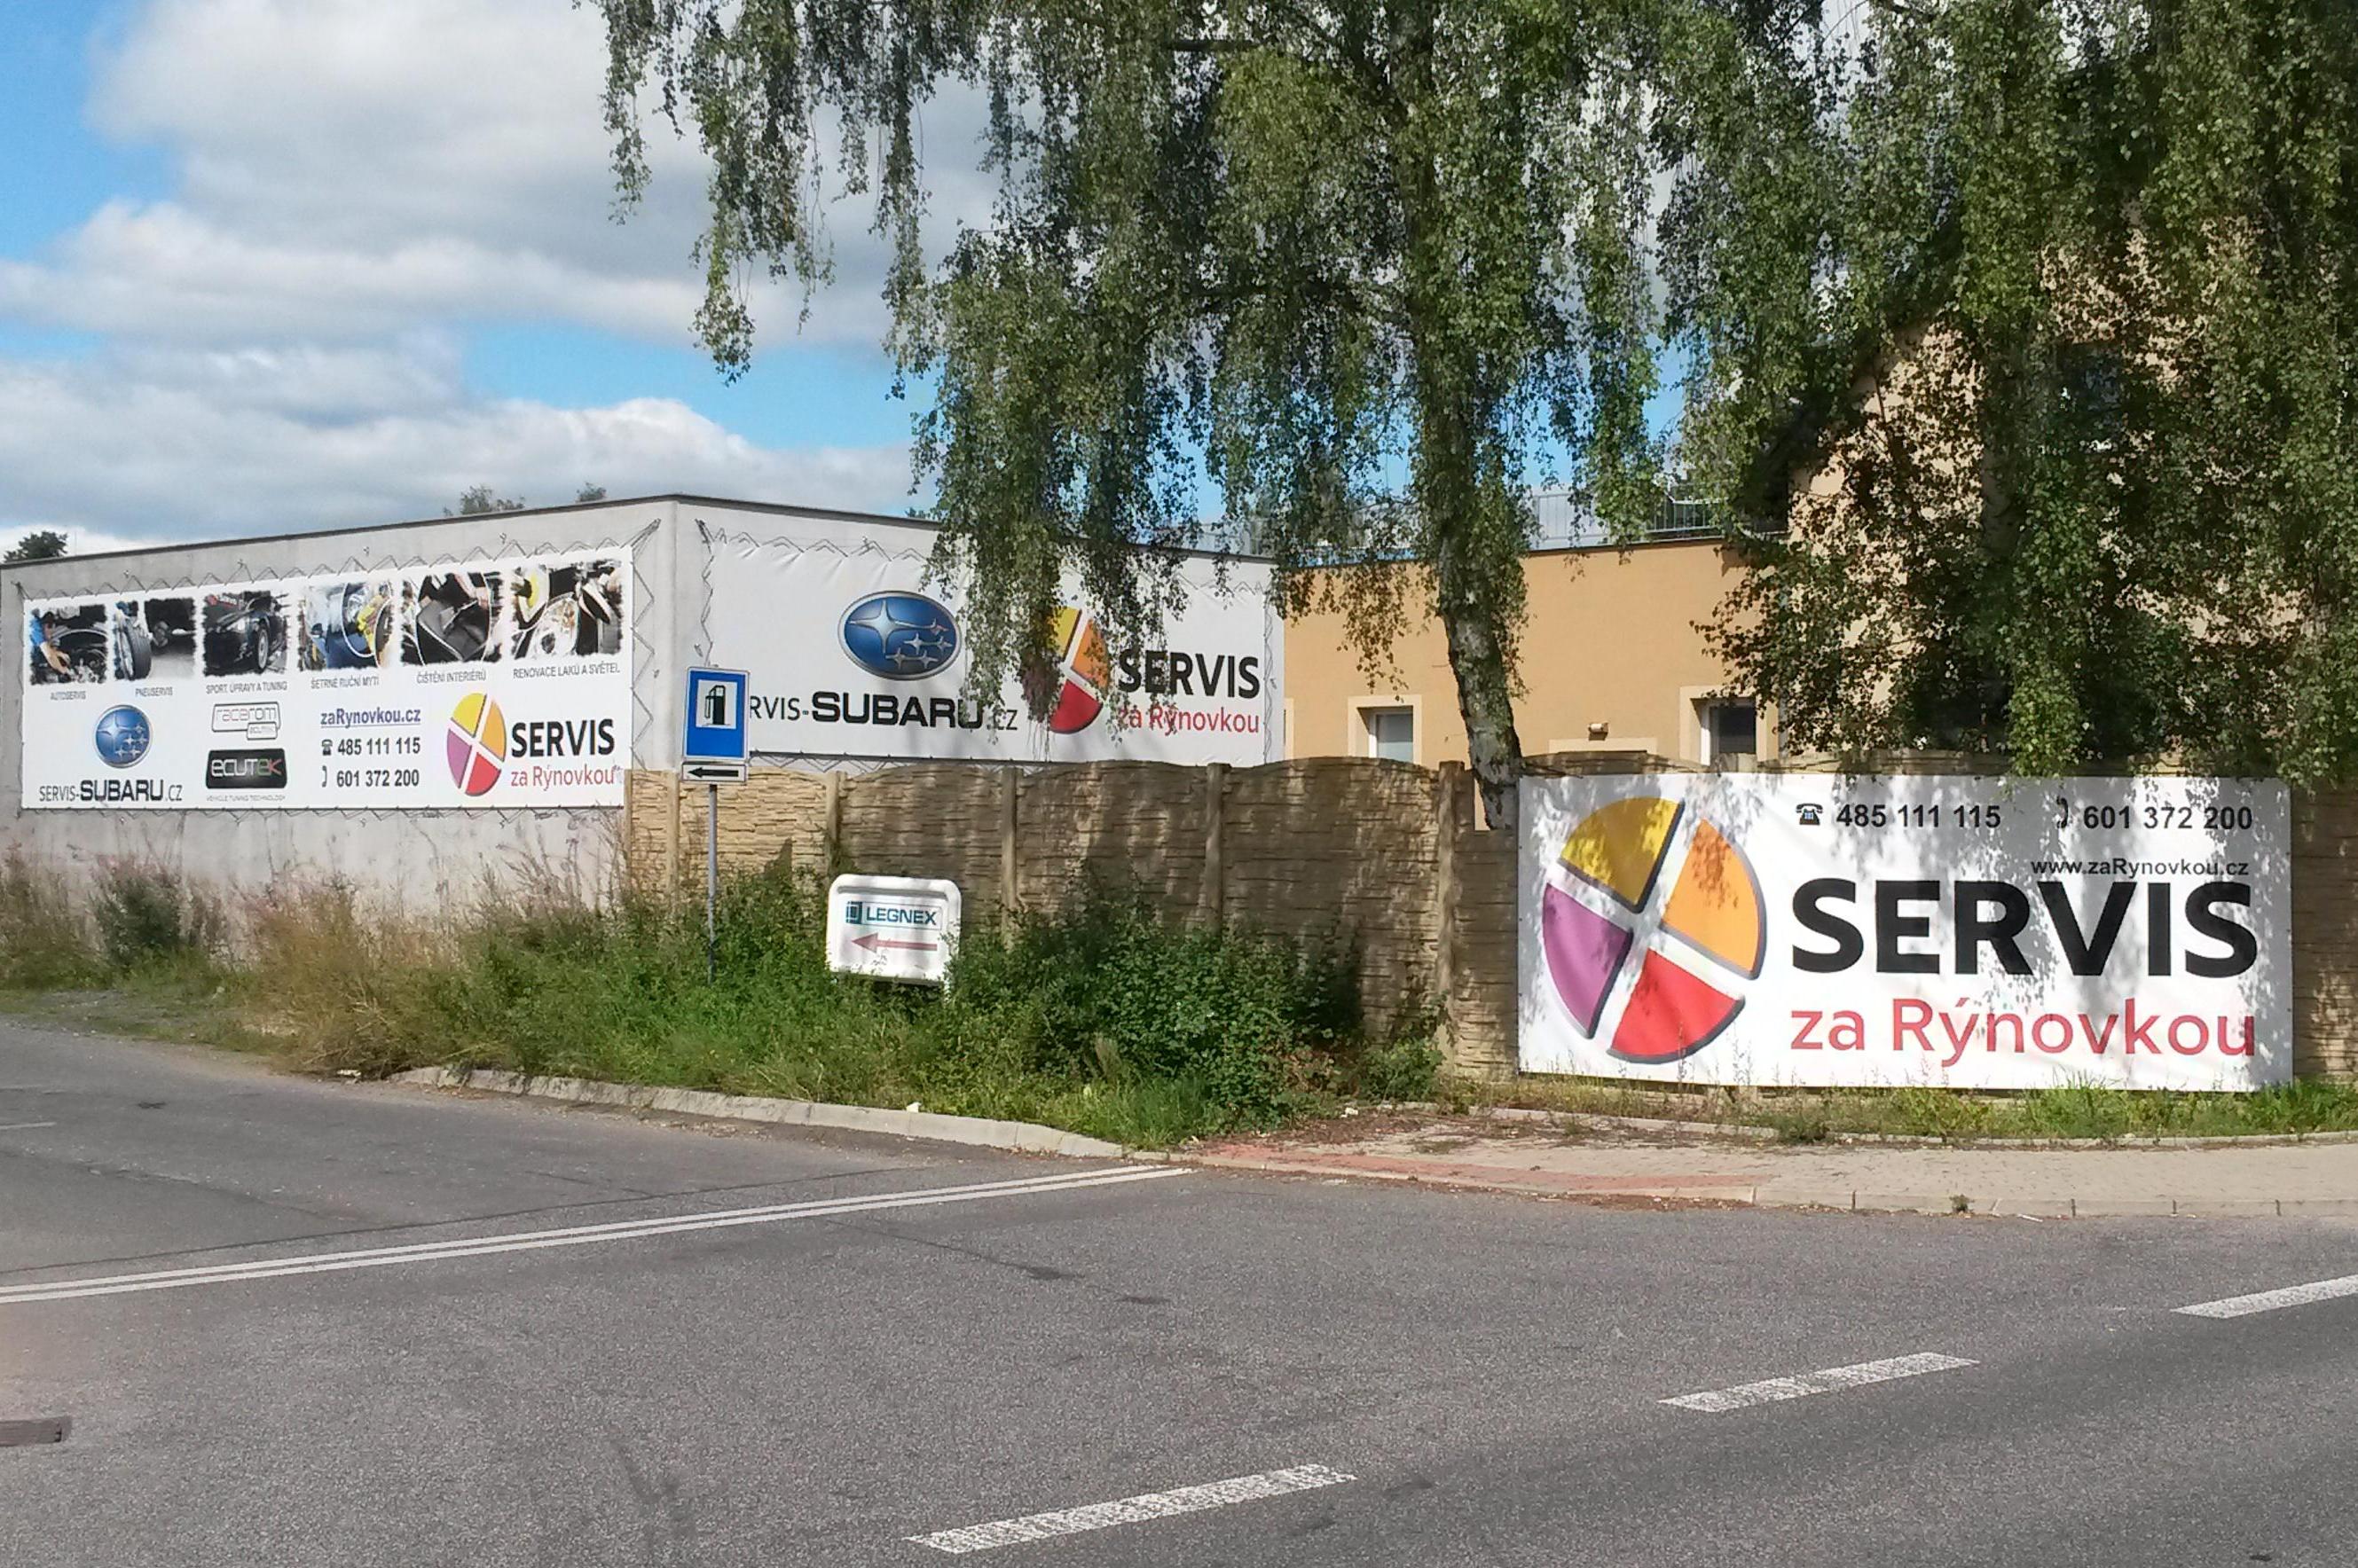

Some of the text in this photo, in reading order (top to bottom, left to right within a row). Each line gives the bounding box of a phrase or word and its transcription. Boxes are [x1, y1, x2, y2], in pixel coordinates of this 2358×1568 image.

[514, 667, 556, 679] RENOVACE
[581, 666, 587, 675] A
[1118, 648, 1261, 699] SERVIS
[320, 707, 421, 728] zaRynovkou.cz
[750, 691, 1018, 730] RVIS-SUBARU.CZ
[337, 737, 421, 756] 485 111 115
[511, 718, 615, 758] SERVIS
[336, 769, 420, 788] 601 372 200
[511, 764, 615, 792] za Rýnovkou
[39, 779, 183, 802] SERVIS-SUBARU.CZ
[1835, 804, 2001, 828] 485 111 115
[2083, 805, 2252, 829] 601 372 200
[2031, 858, 2250, 879] www.zaRynovkou.cz
[866, 906, 938, 926] LEGNEX
[1791, 877, 2259, 978] SERVIS
[1790, 997, 2256, 1068] za Rýnovkou
